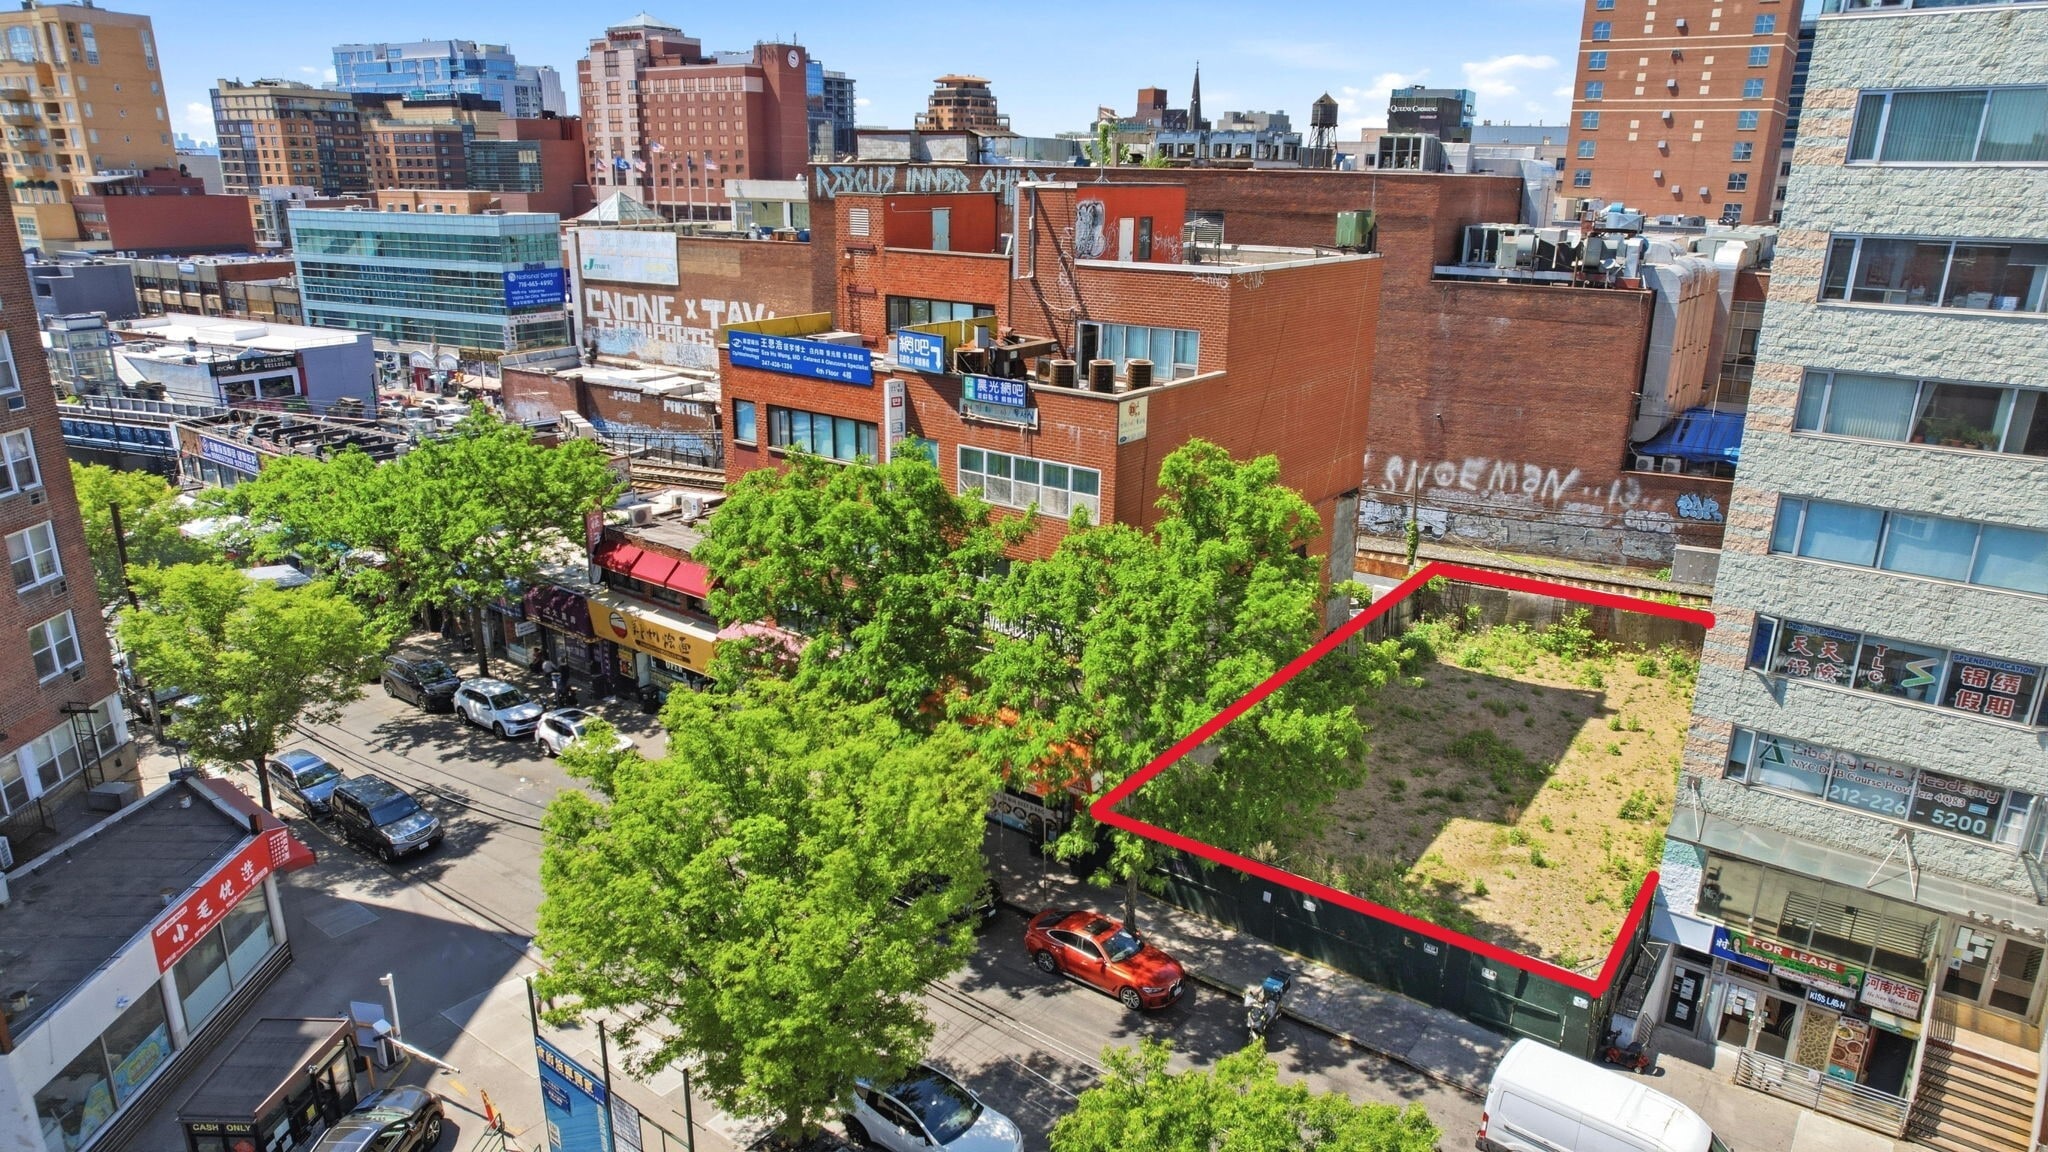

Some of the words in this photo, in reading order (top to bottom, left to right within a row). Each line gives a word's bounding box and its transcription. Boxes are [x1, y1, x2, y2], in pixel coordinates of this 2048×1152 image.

[1788, 635, 1845, 663] 天天
[1953, 654, 1995, 667] SPLENDID
[1994, 661, 2036, 675] VACATION
[1960, 665, 2022, 695] 锦绣
[1954, 688, 2016, 718] 假期
[1790, 759, 1817, 773] NYC
[1847, 772, 1883, 787] Course
[1863, 761, 1905, 779] Arts
[1931, 808, 1987, 835] 5200
[1752, 938, 1784, 956] FOR
[1790, 950, 1838, 973] LEASE
[1809, 991, 1826, 1004] KISS
[192, 1123, 219, 1131] CASH
